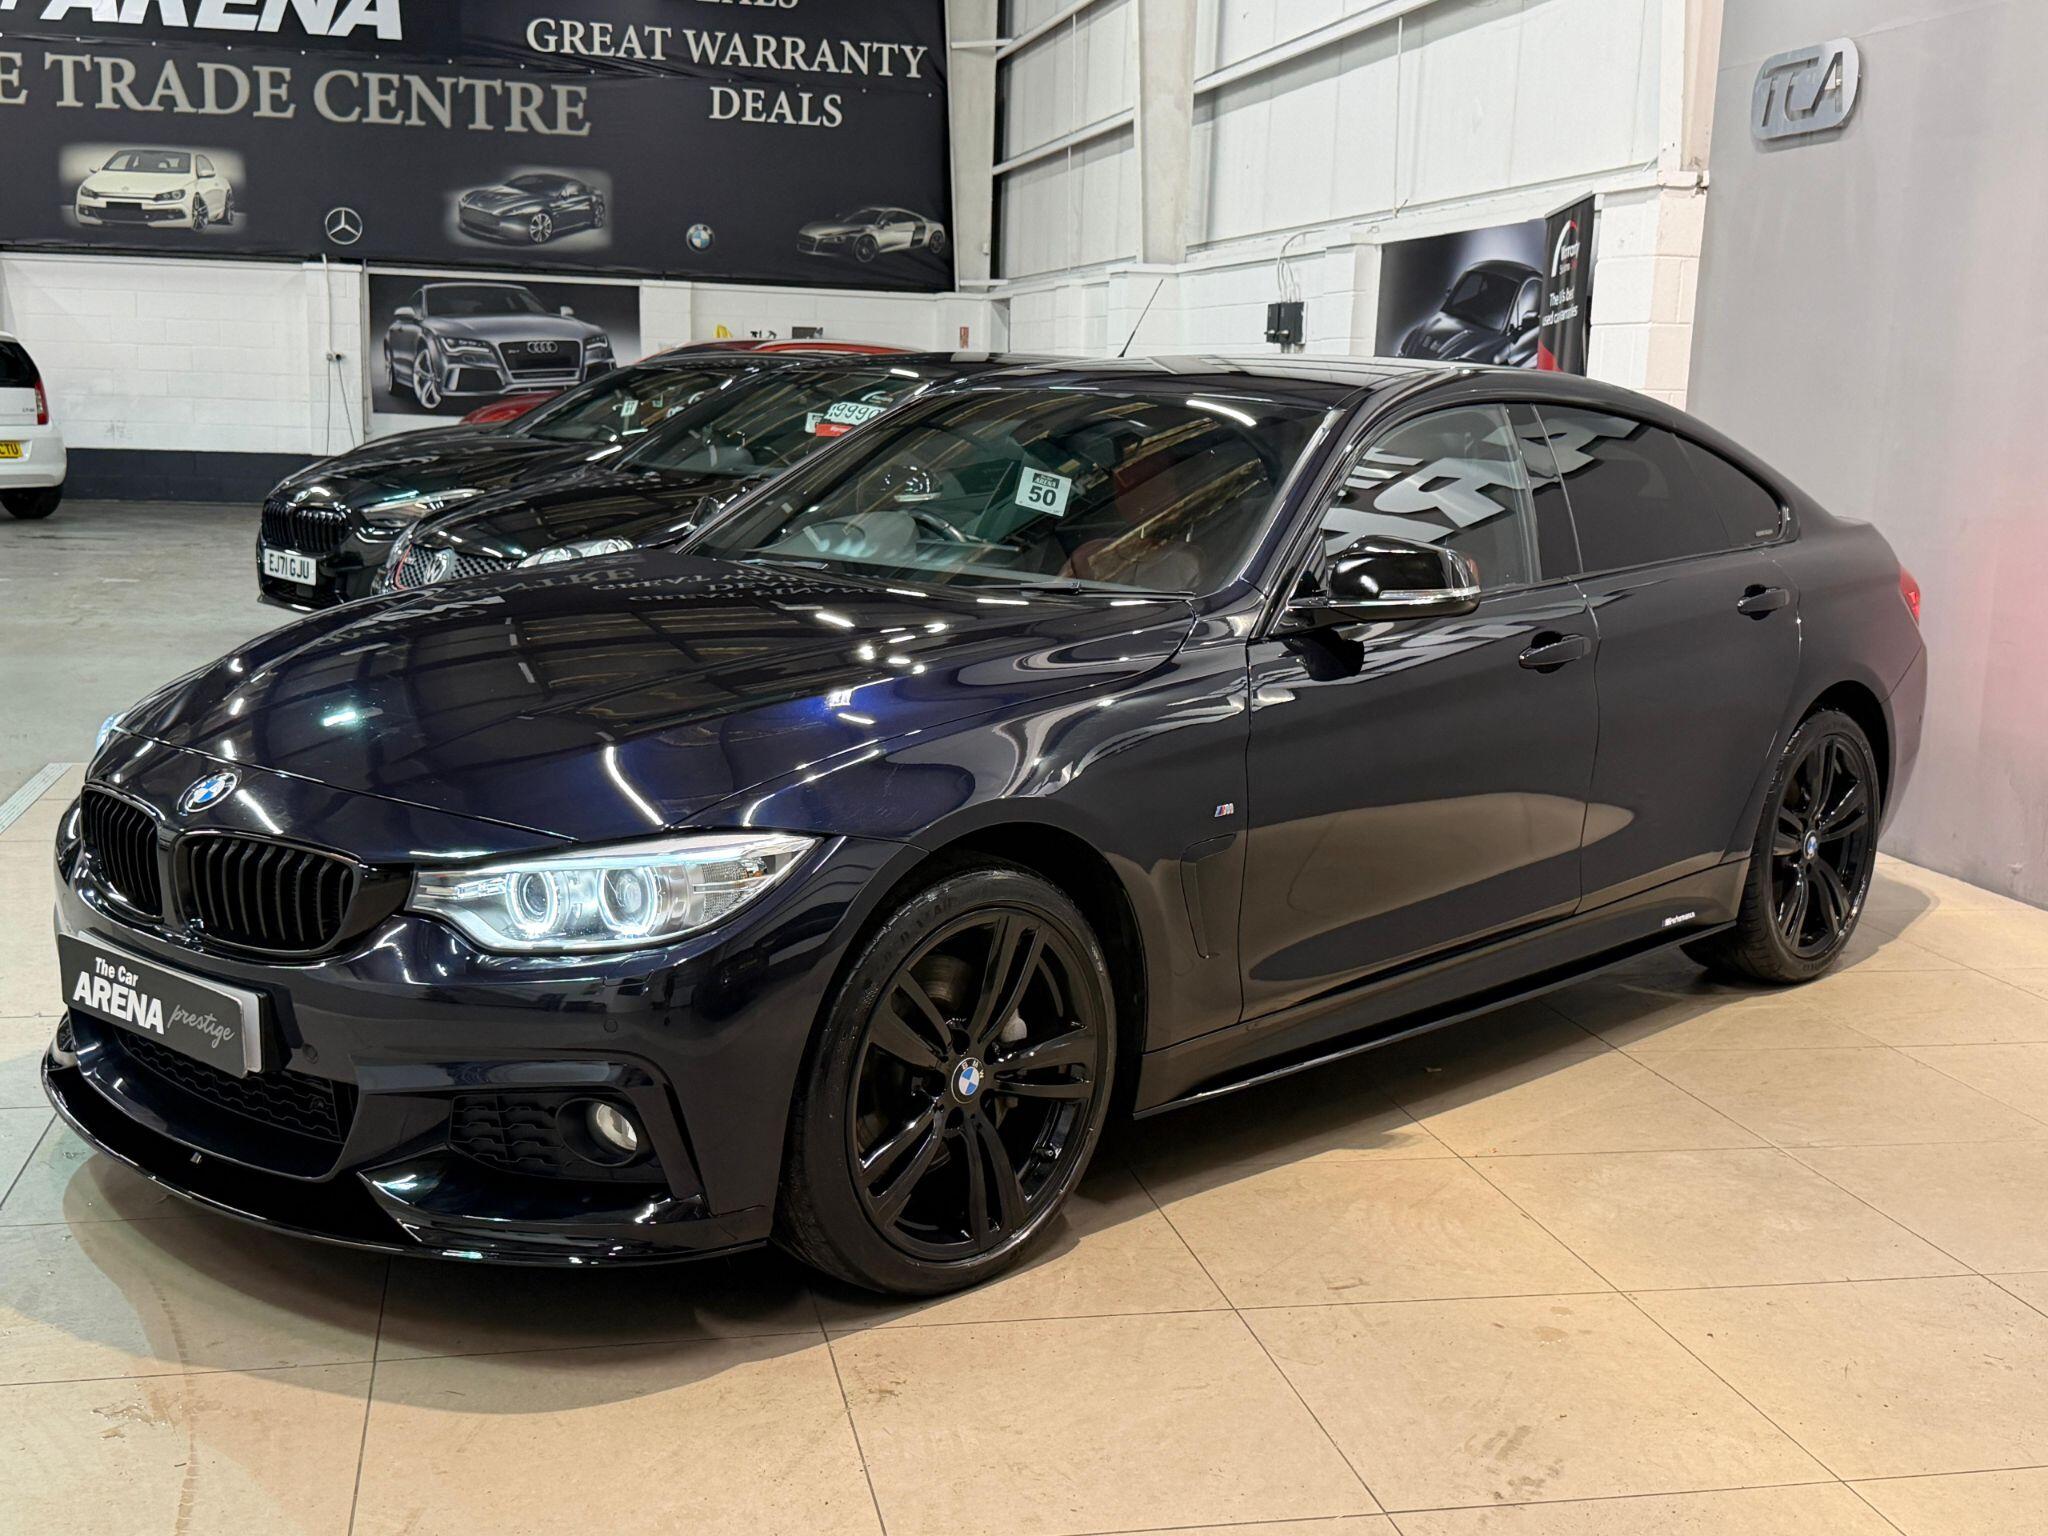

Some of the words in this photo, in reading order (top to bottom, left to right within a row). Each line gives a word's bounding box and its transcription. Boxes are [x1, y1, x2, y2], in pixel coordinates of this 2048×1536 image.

[526, 18, 671, 61] GREAT
[683, 30, 927, 78] WARRANTY
[44, 52, 296, 118] TRADE
[313, 70, 591, 136] CENTRE
[709, 87, 843, 128] DEALS
[1028, 485, 1056, 506] 50
[269, 553, 288, 576] EJ71
[289, 558, 309, 580] GJU
[95, 957, 115, 978] The
[117, 965, 139, 987] Car
[73, 971, 165, 1035] ARENA
[167, 1004, 235, 1048] prestige
